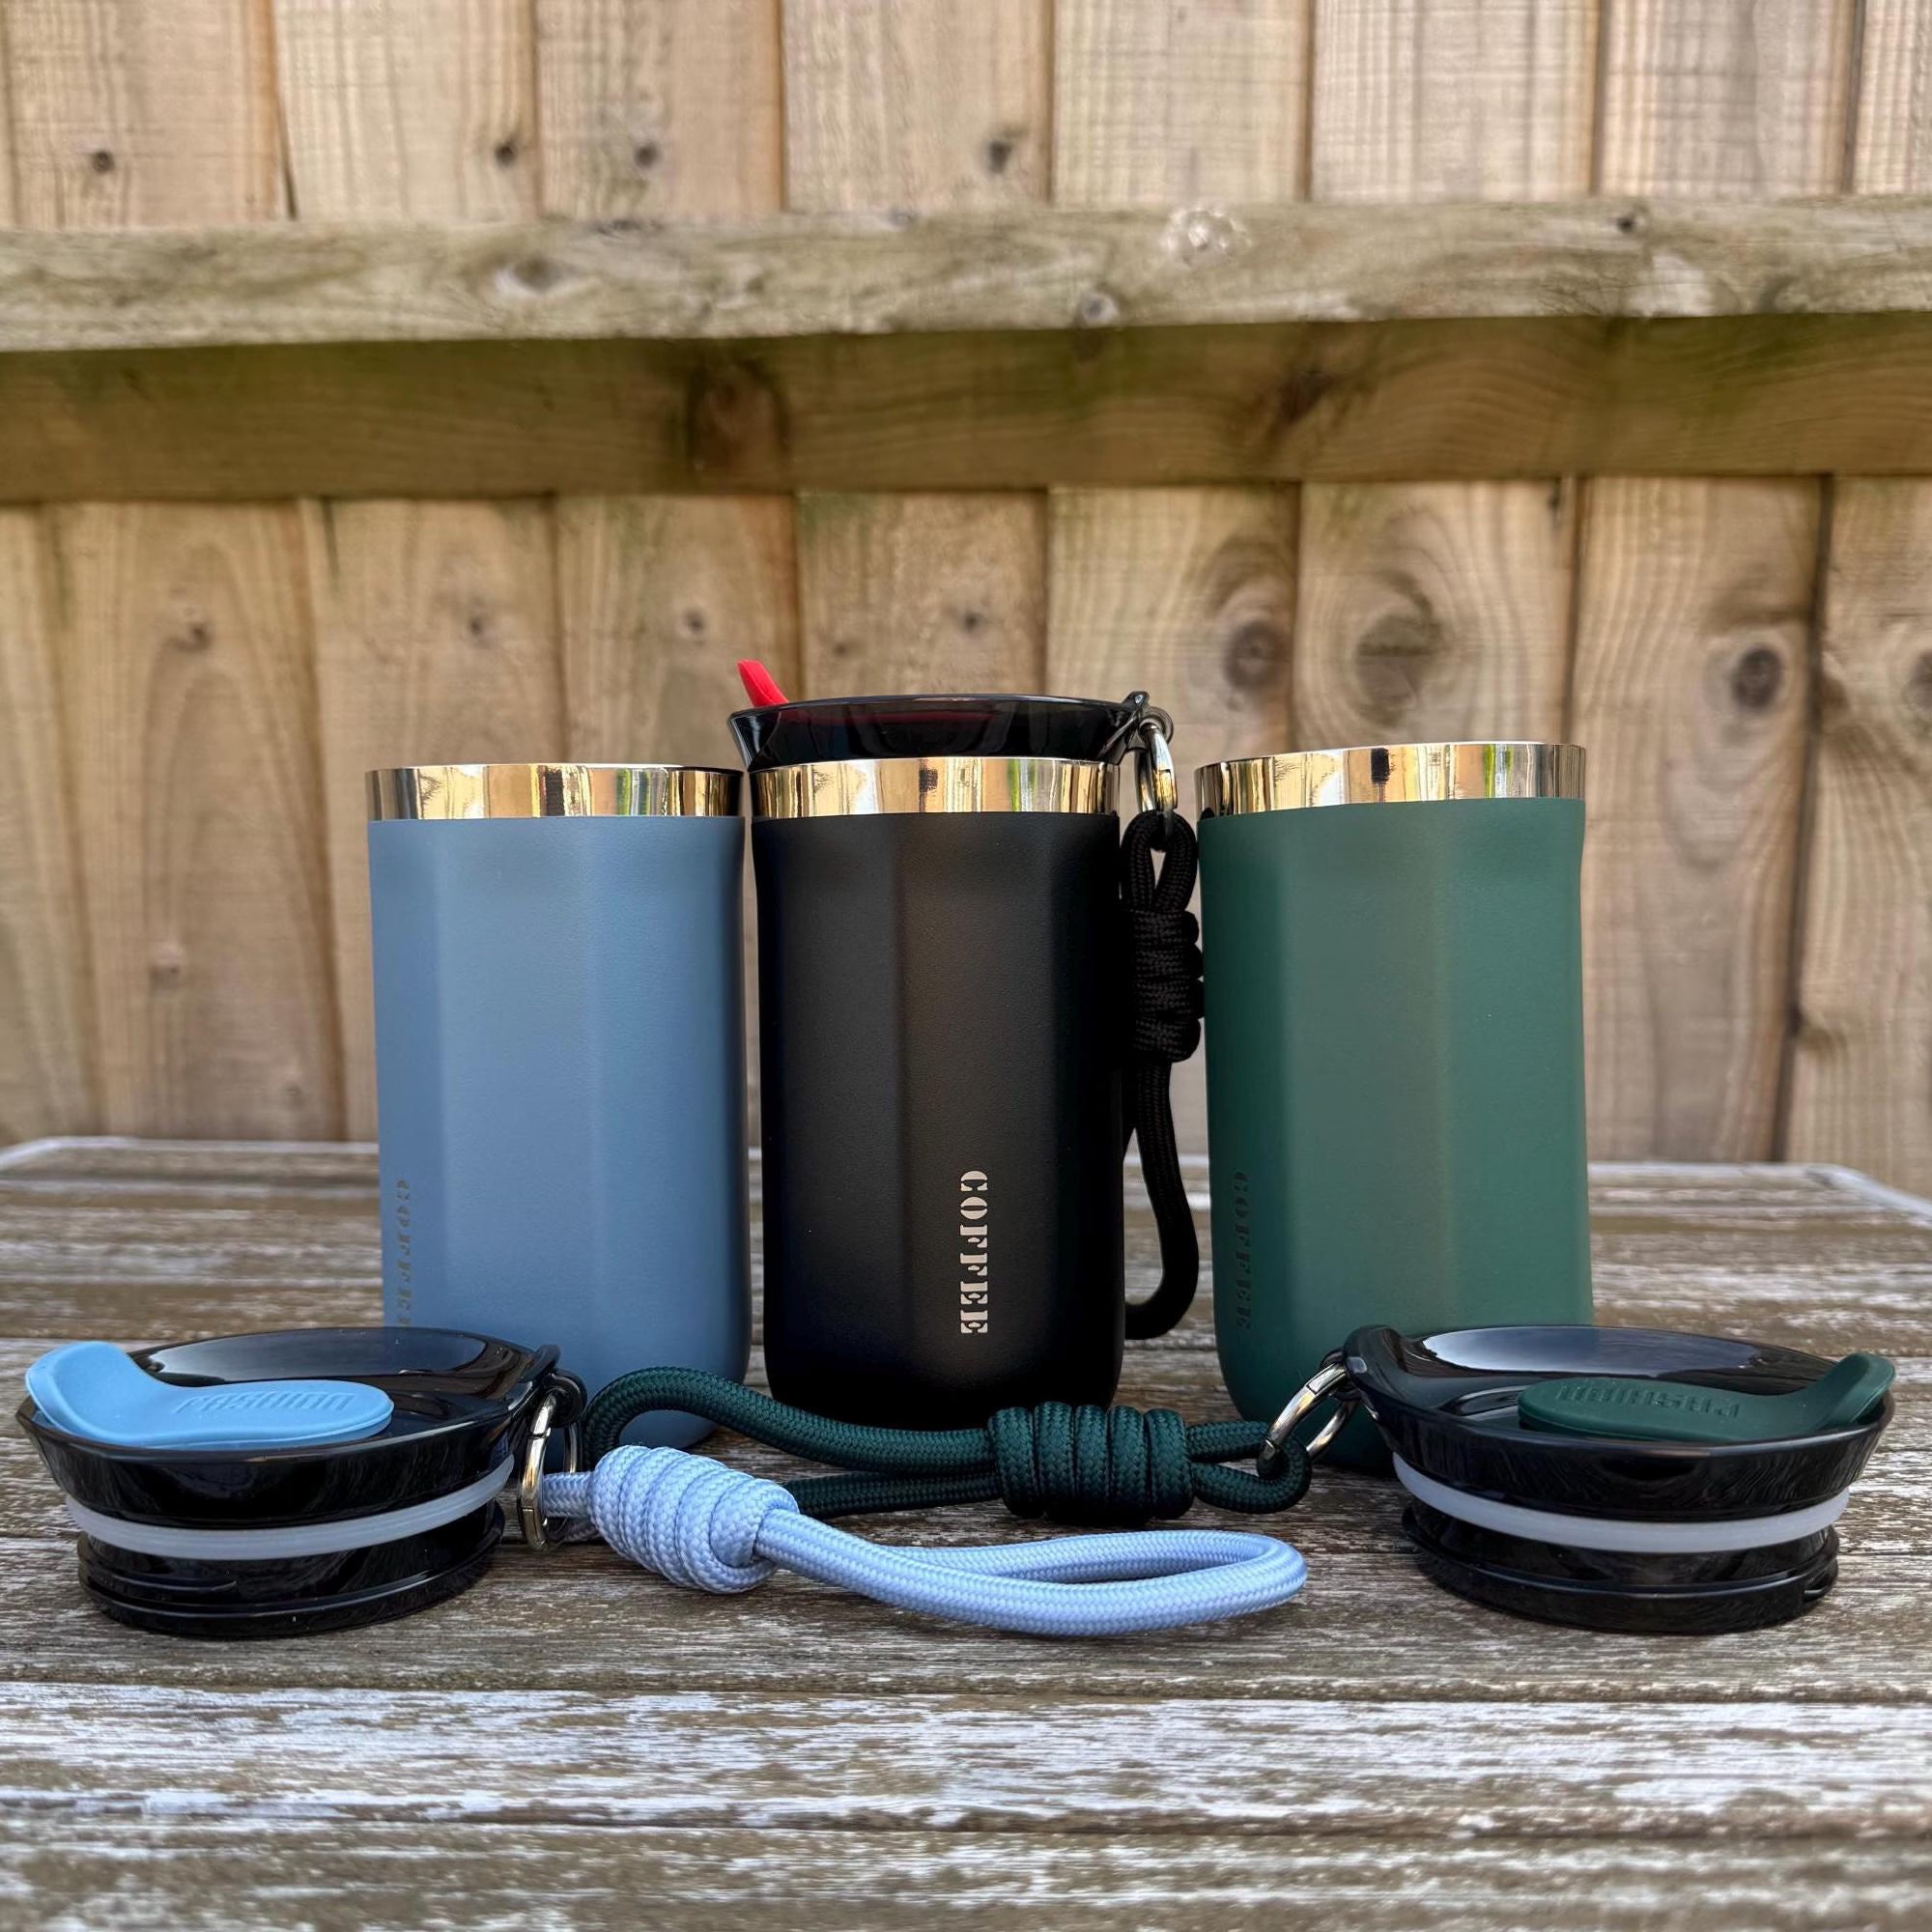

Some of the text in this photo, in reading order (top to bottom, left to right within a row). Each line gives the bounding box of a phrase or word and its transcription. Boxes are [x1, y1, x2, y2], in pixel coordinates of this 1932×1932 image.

[960, 1170, 988, 1334] COFFEE
[1233, 1172, 1251, 1330] COFFEE
[173, 1391, 355, 1414] FASHION
[1556, 1384, 1740, 1418] FASHION
